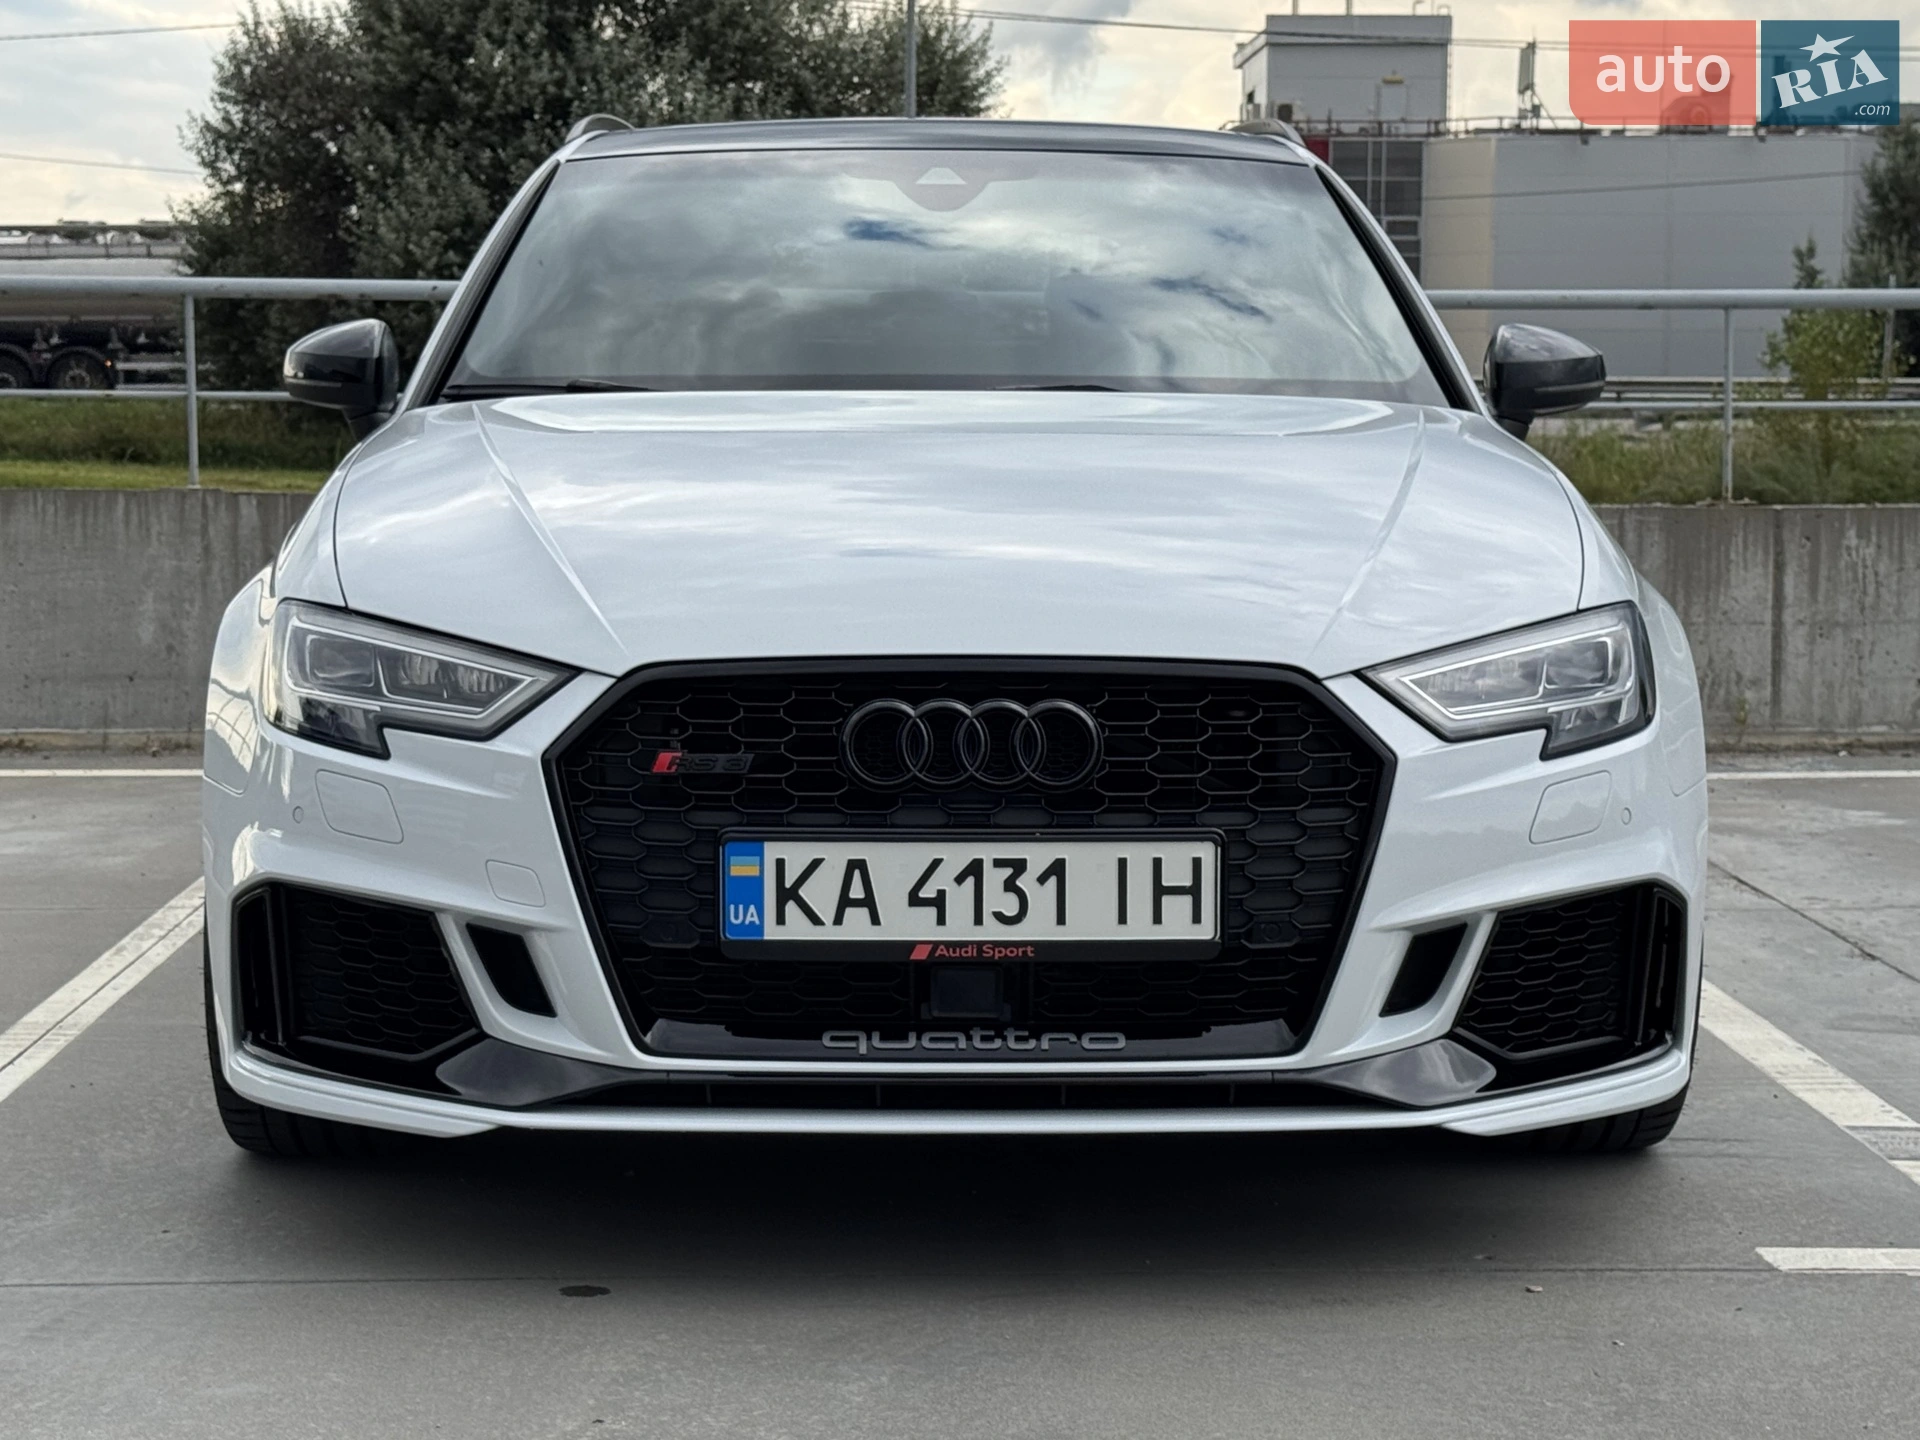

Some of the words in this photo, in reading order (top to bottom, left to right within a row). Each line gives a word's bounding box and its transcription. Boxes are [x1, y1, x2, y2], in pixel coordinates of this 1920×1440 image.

[774, 857, 882, 926] KA
[907, 857, 1067, 926] 4131
[1117, 856, 1203, 926] IH
[729, 905, 760, 926] UA
[934, 944, 978, 958] Audi
[982, 944, 1035, 960] Sport
[821, 1027, 1127, 1055] quattro
